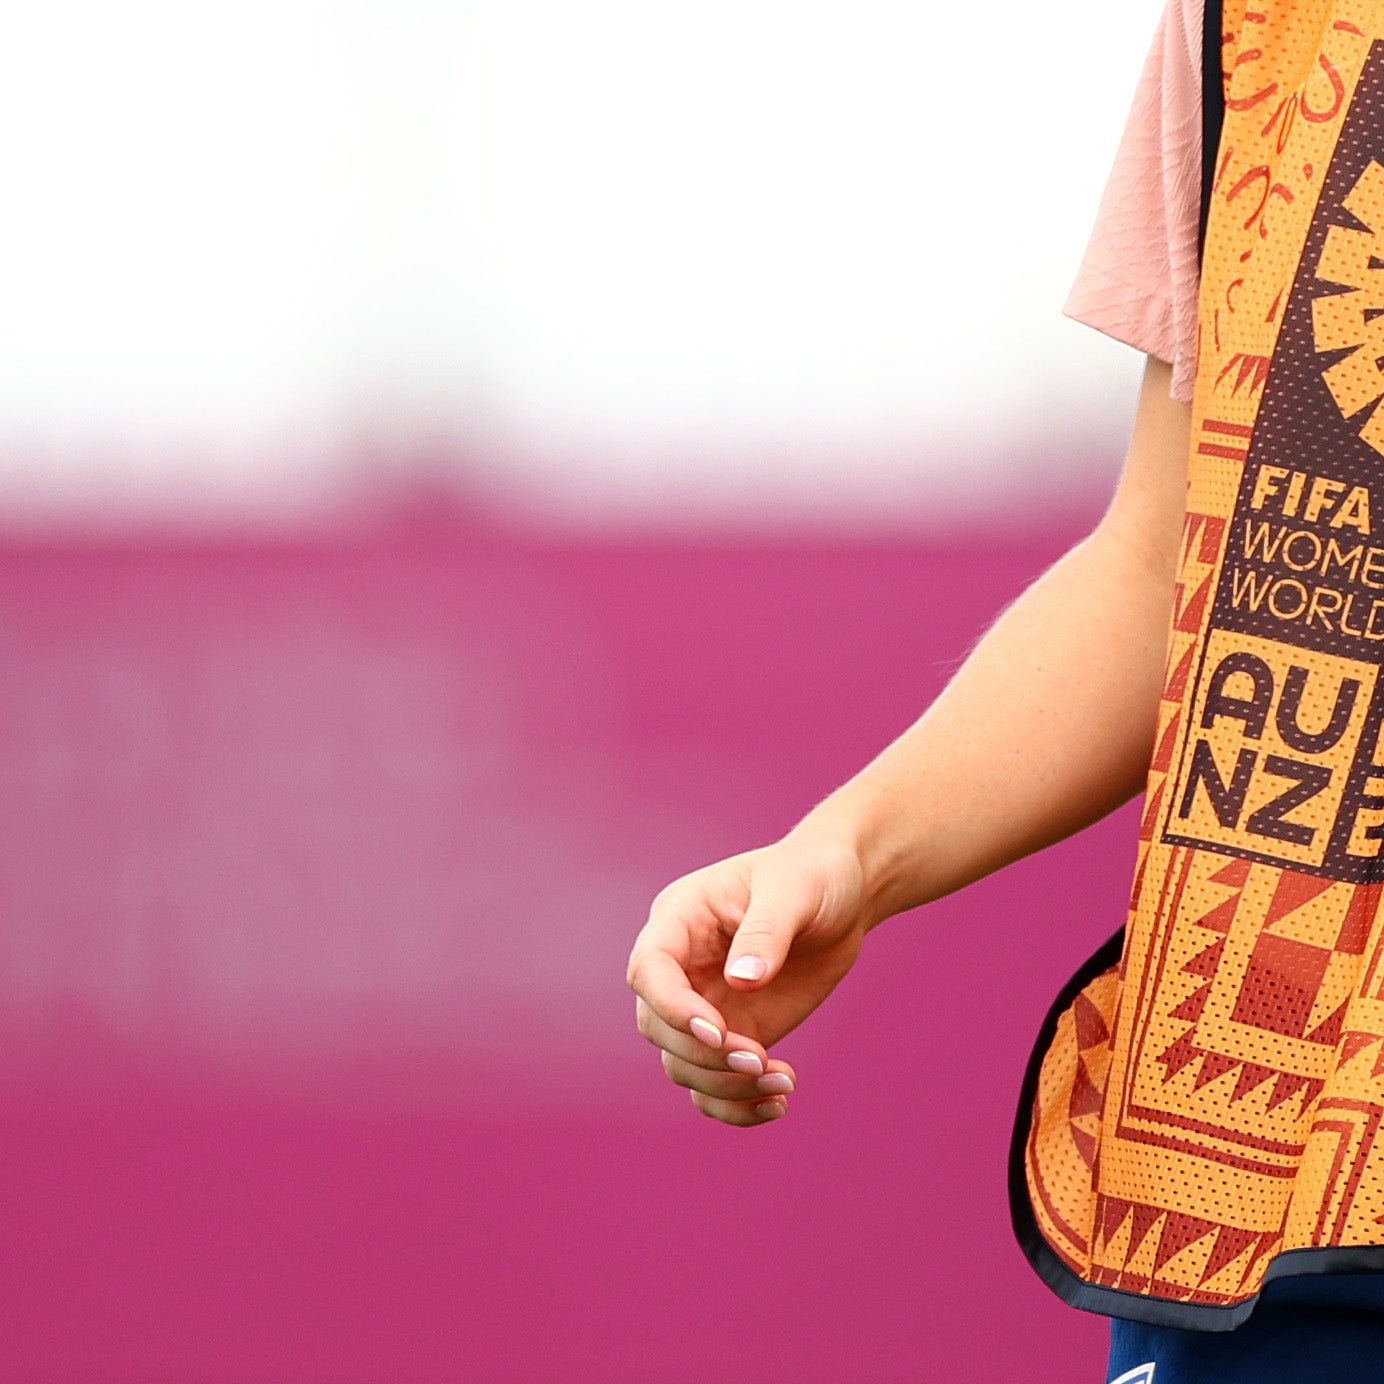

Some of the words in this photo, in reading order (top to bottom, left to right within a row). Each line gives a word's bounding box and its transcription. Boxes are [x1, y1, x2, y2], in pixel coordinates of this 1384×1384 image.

[1251, 464, 1371, 535] FIFA
[1201, 651, 1362, 755] AU
[1178, 737, 1333, 846] NZ
